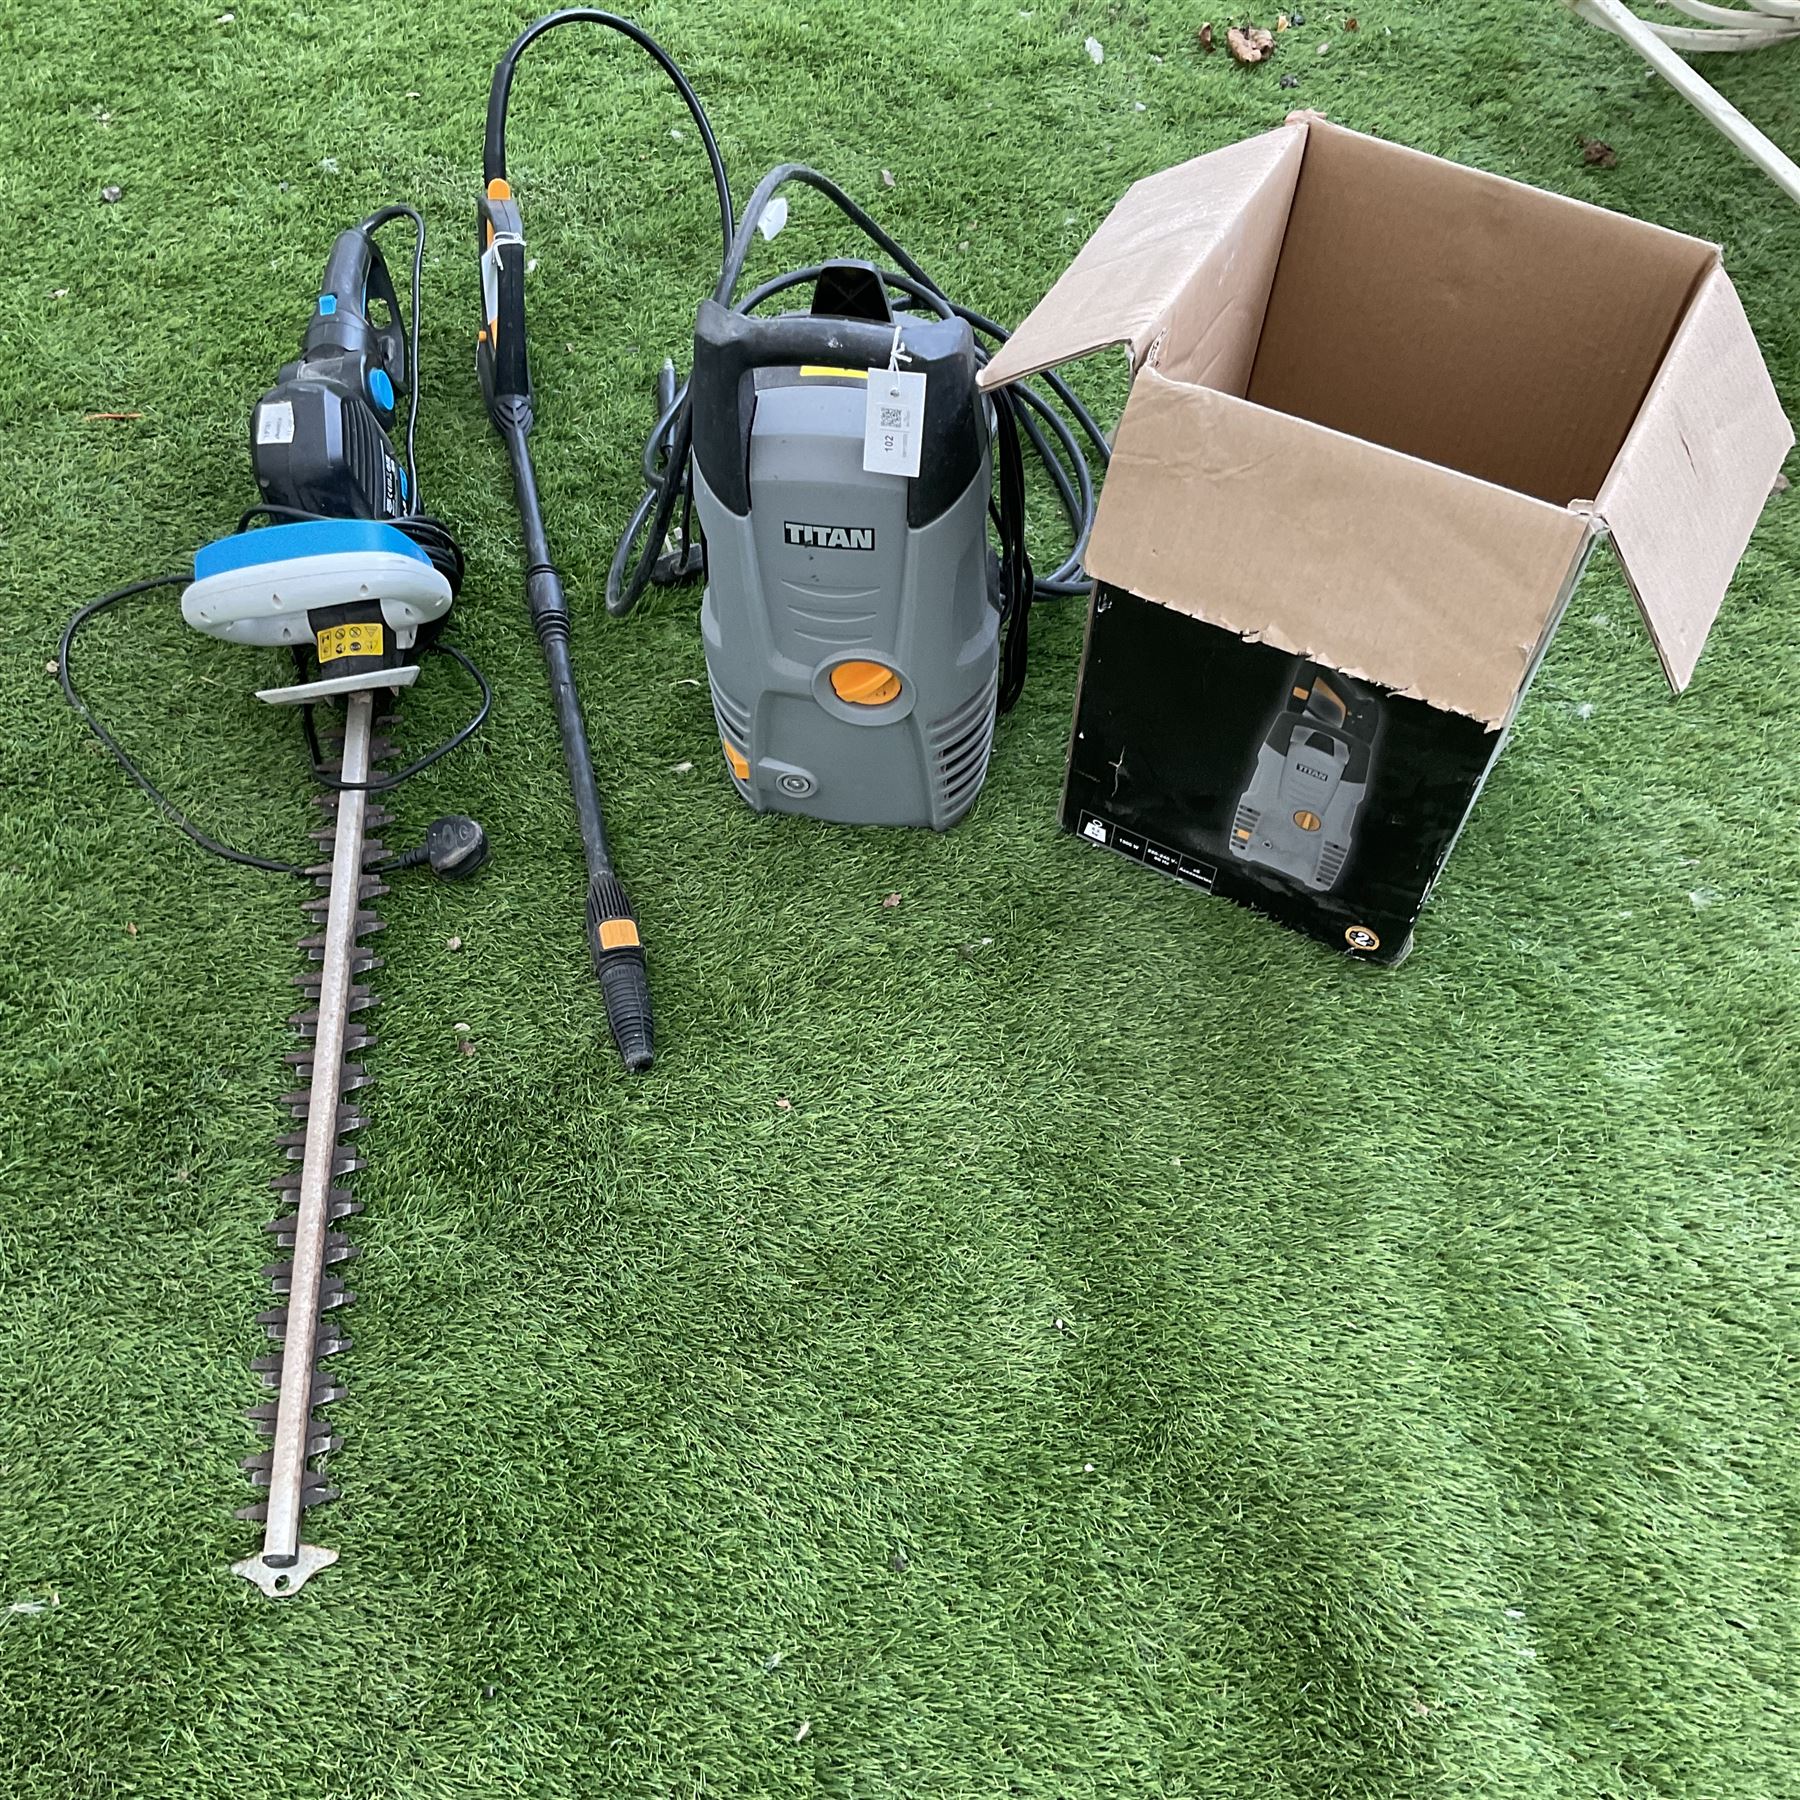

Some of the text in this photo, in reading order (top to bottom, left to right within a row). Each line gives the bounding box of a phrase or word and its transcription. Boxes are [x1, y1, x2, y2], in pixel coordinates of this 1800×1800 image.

[884, 434, 895, 453] 102
[784, 522, 873, 549] TITAN
[1297, 765, 1328, 781] TITAN
[1354, 931, 1370, 947] 2
